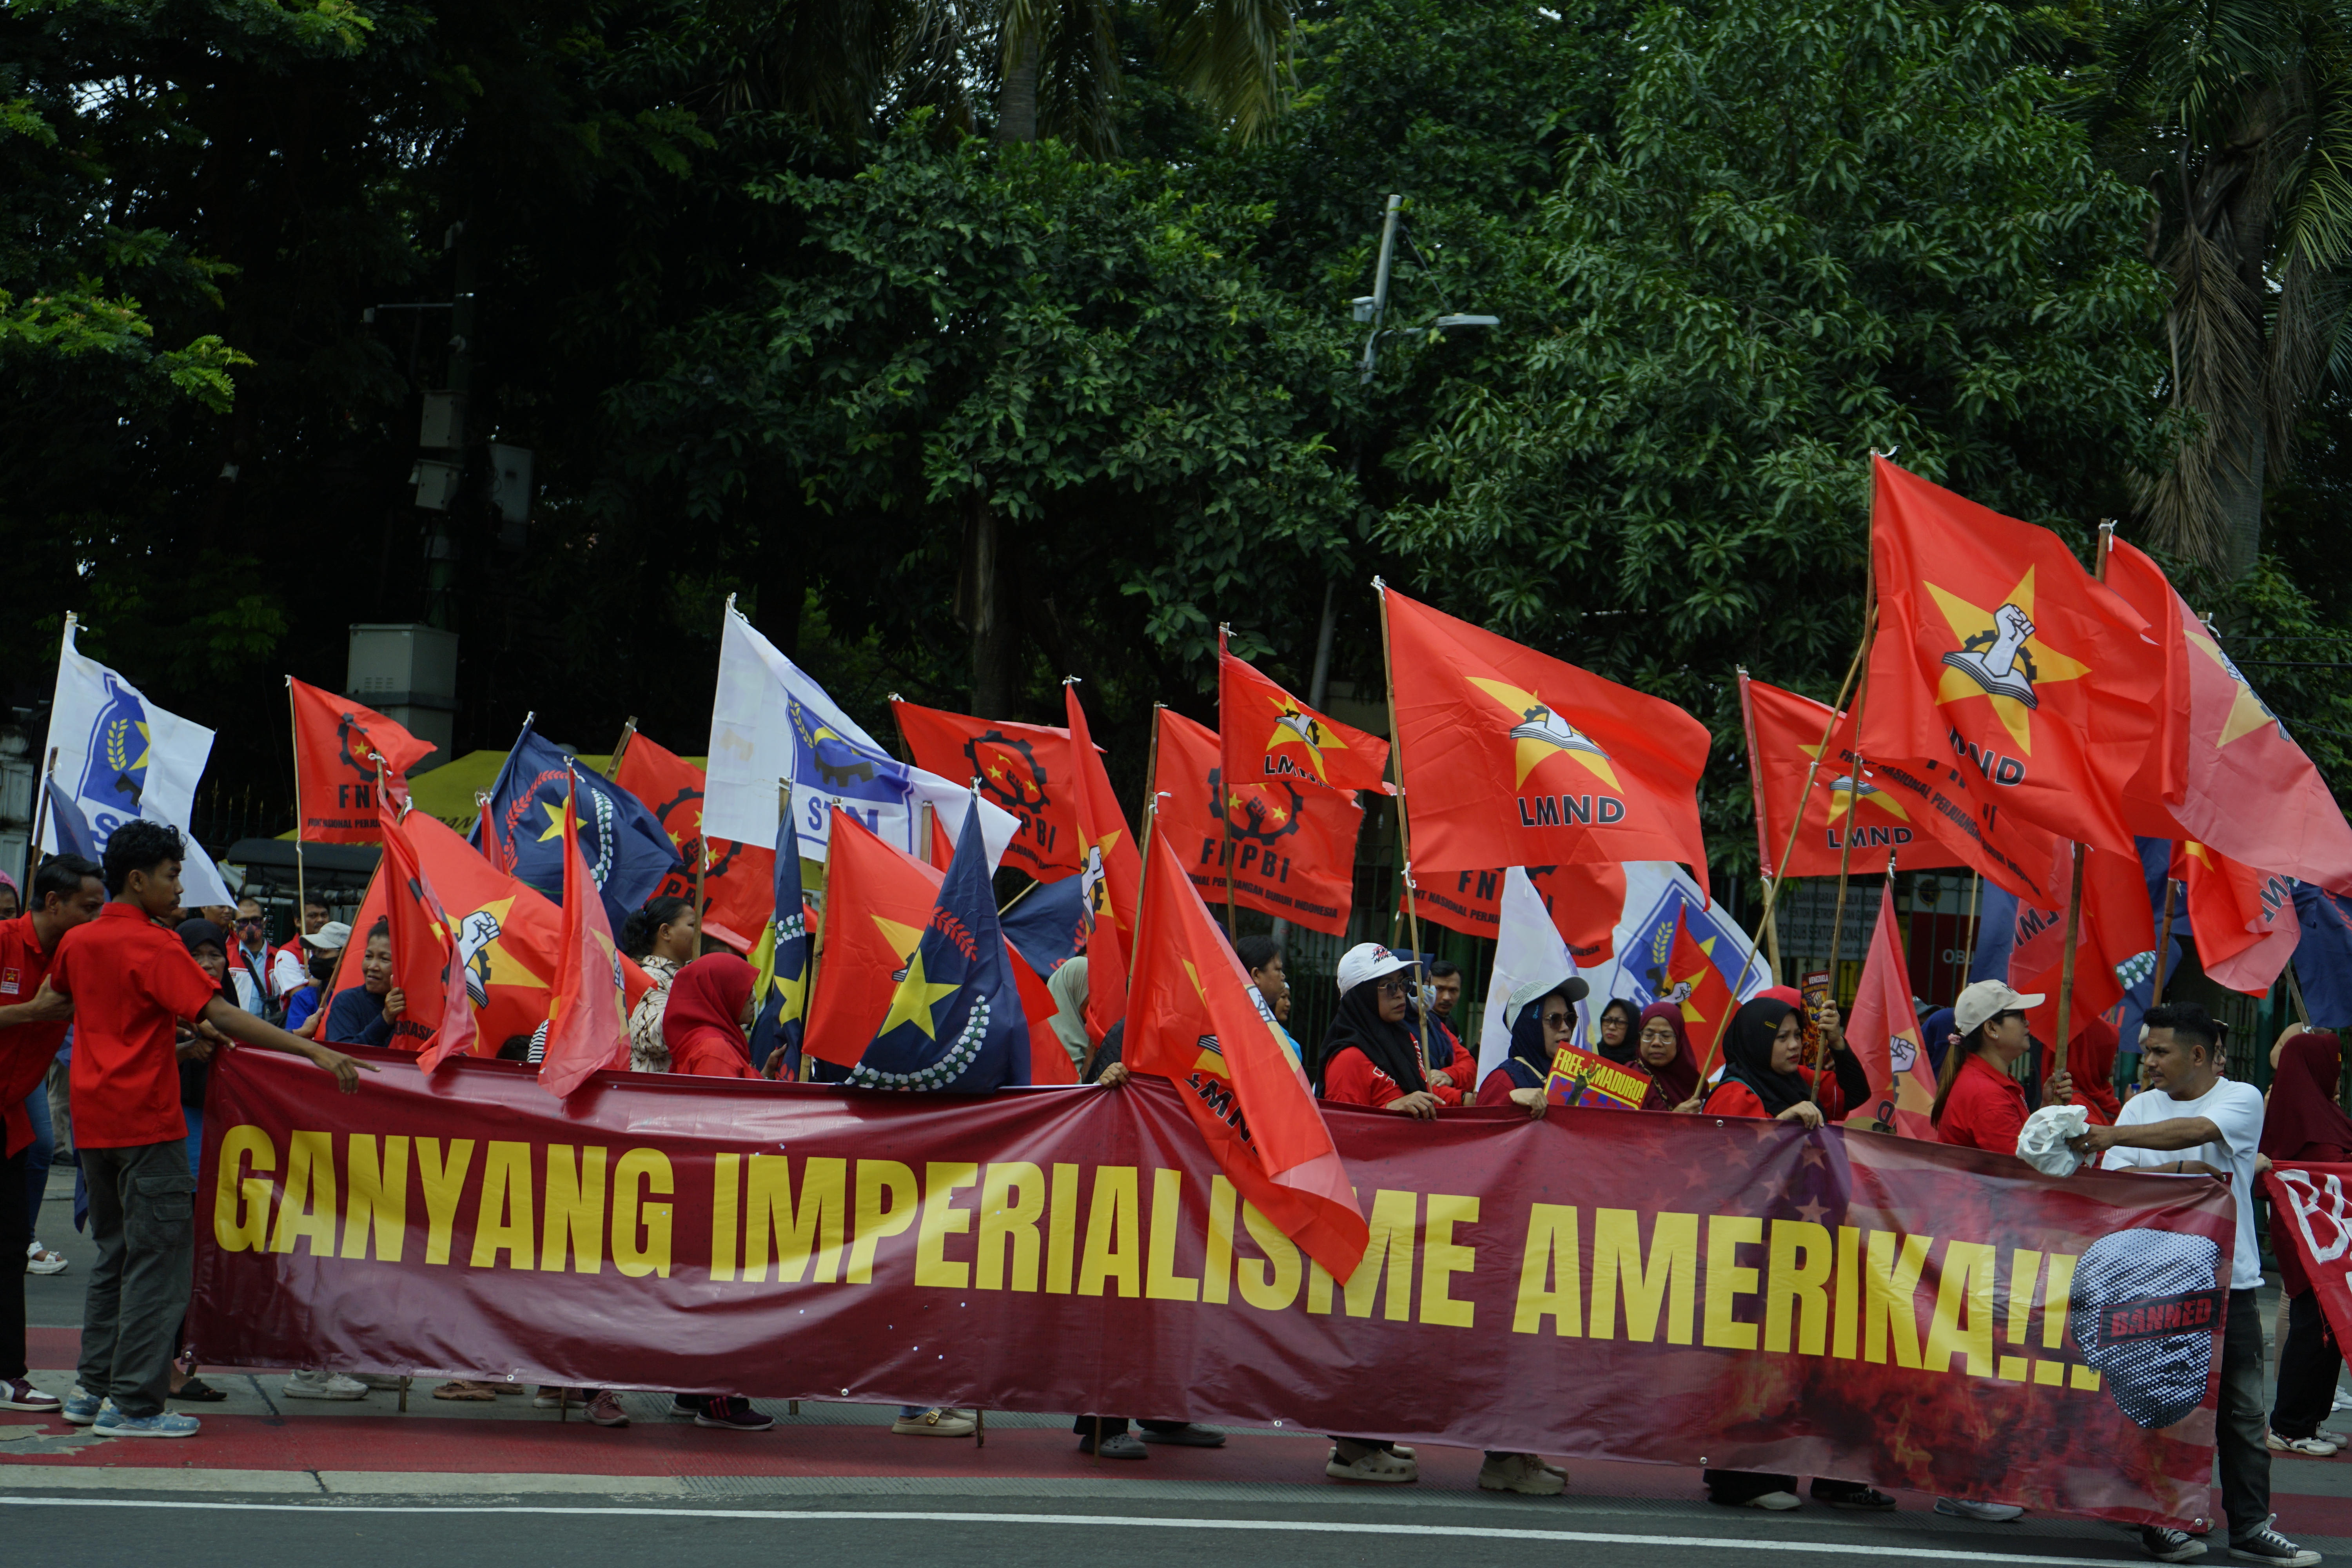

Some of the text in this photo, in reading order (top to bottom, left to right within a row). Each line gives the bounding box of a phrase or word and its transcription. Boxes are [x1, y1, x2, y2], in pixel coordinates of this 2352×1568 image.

[1517, 795, 1626, 827] LMND
[1428, 892, 1466, 916] NASIONAL
[1809, 974, 1828, 985] VENEZUELA
[1553, 1047, 1648, 1103] FREE MADURO!
[214, 1124, 675, 1279] GANYANG
[710, 1152, 1480, 1328] IMPERIALISME
[2111, 1297, 2212, 1337] BANNED
